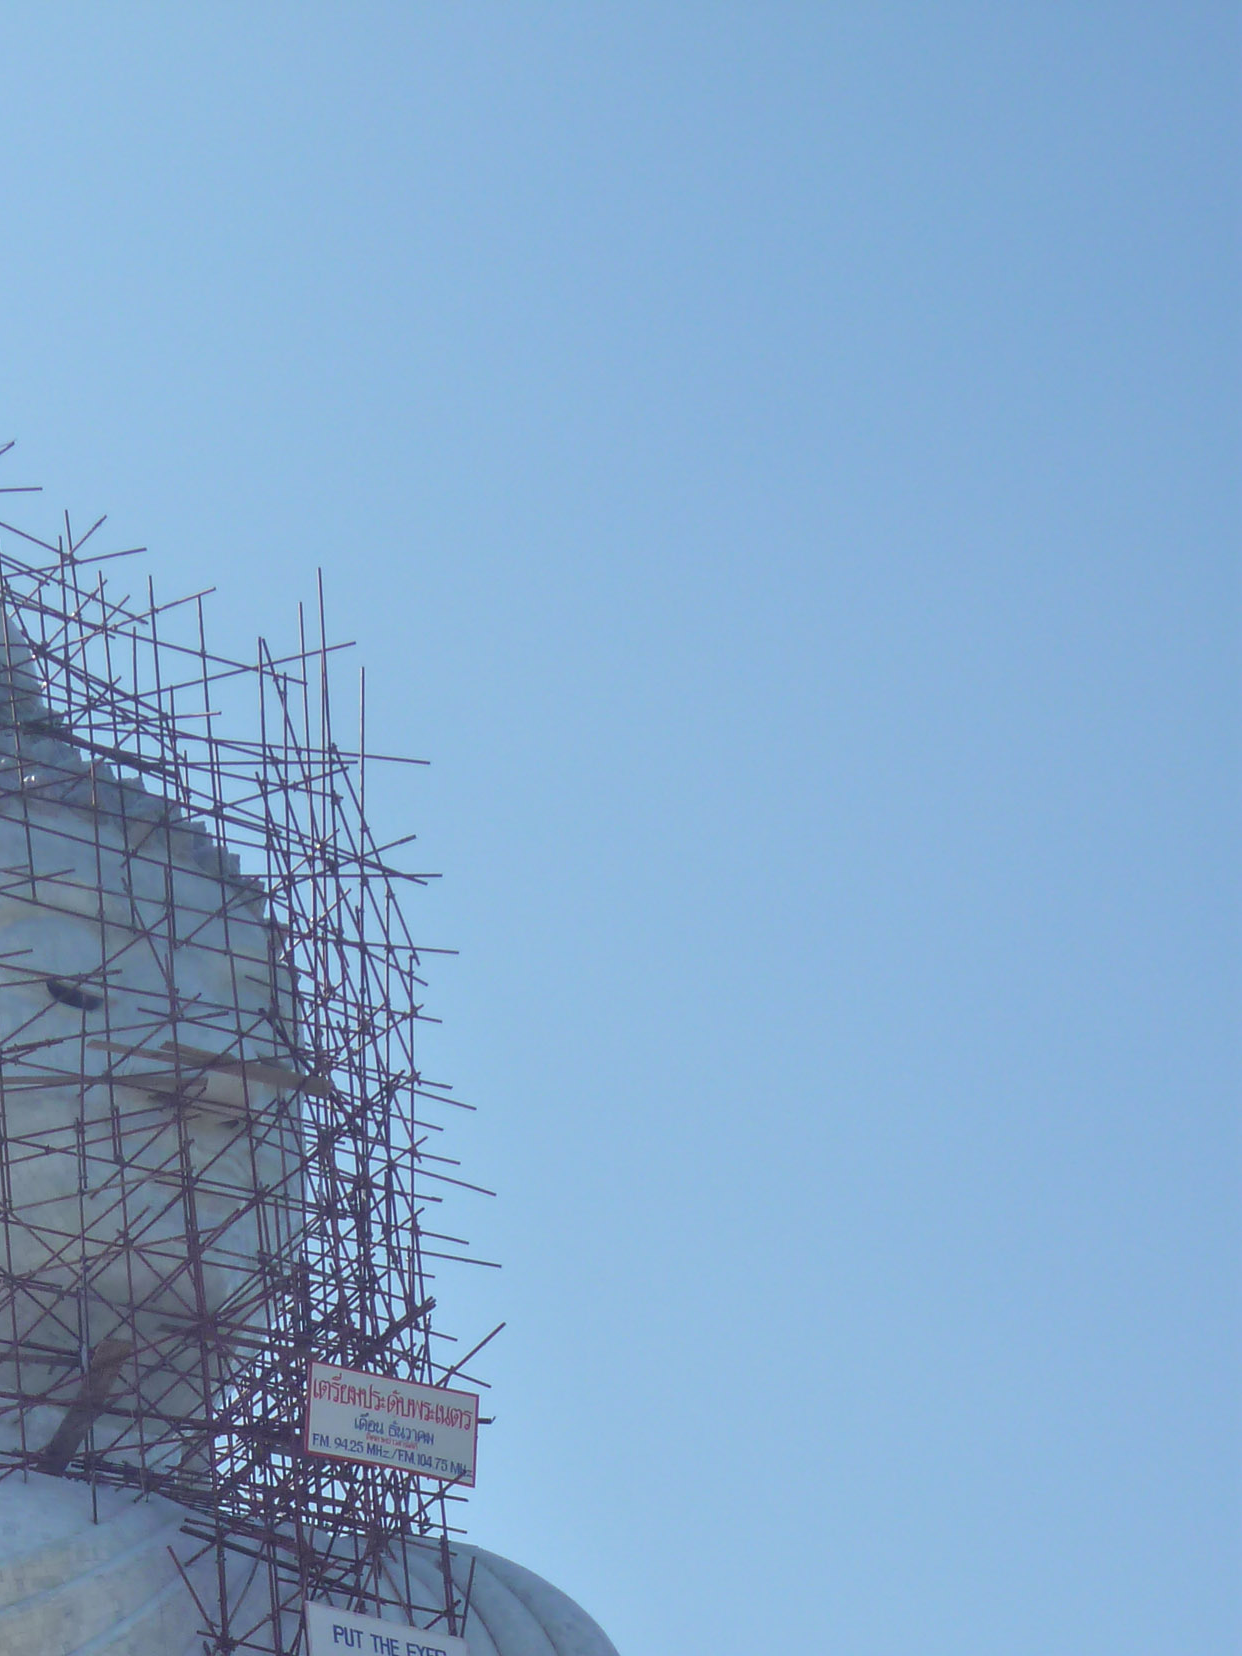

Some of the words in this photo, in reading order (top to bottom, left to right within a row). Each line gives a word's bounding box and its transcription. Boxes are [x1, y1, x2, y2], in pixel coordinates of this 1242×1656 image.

[354, 1412, 384, 1435] เดือน
[388, 1420, 434, 1446] ธันวาคม
[333, 1624, 363, 1649] PUT
